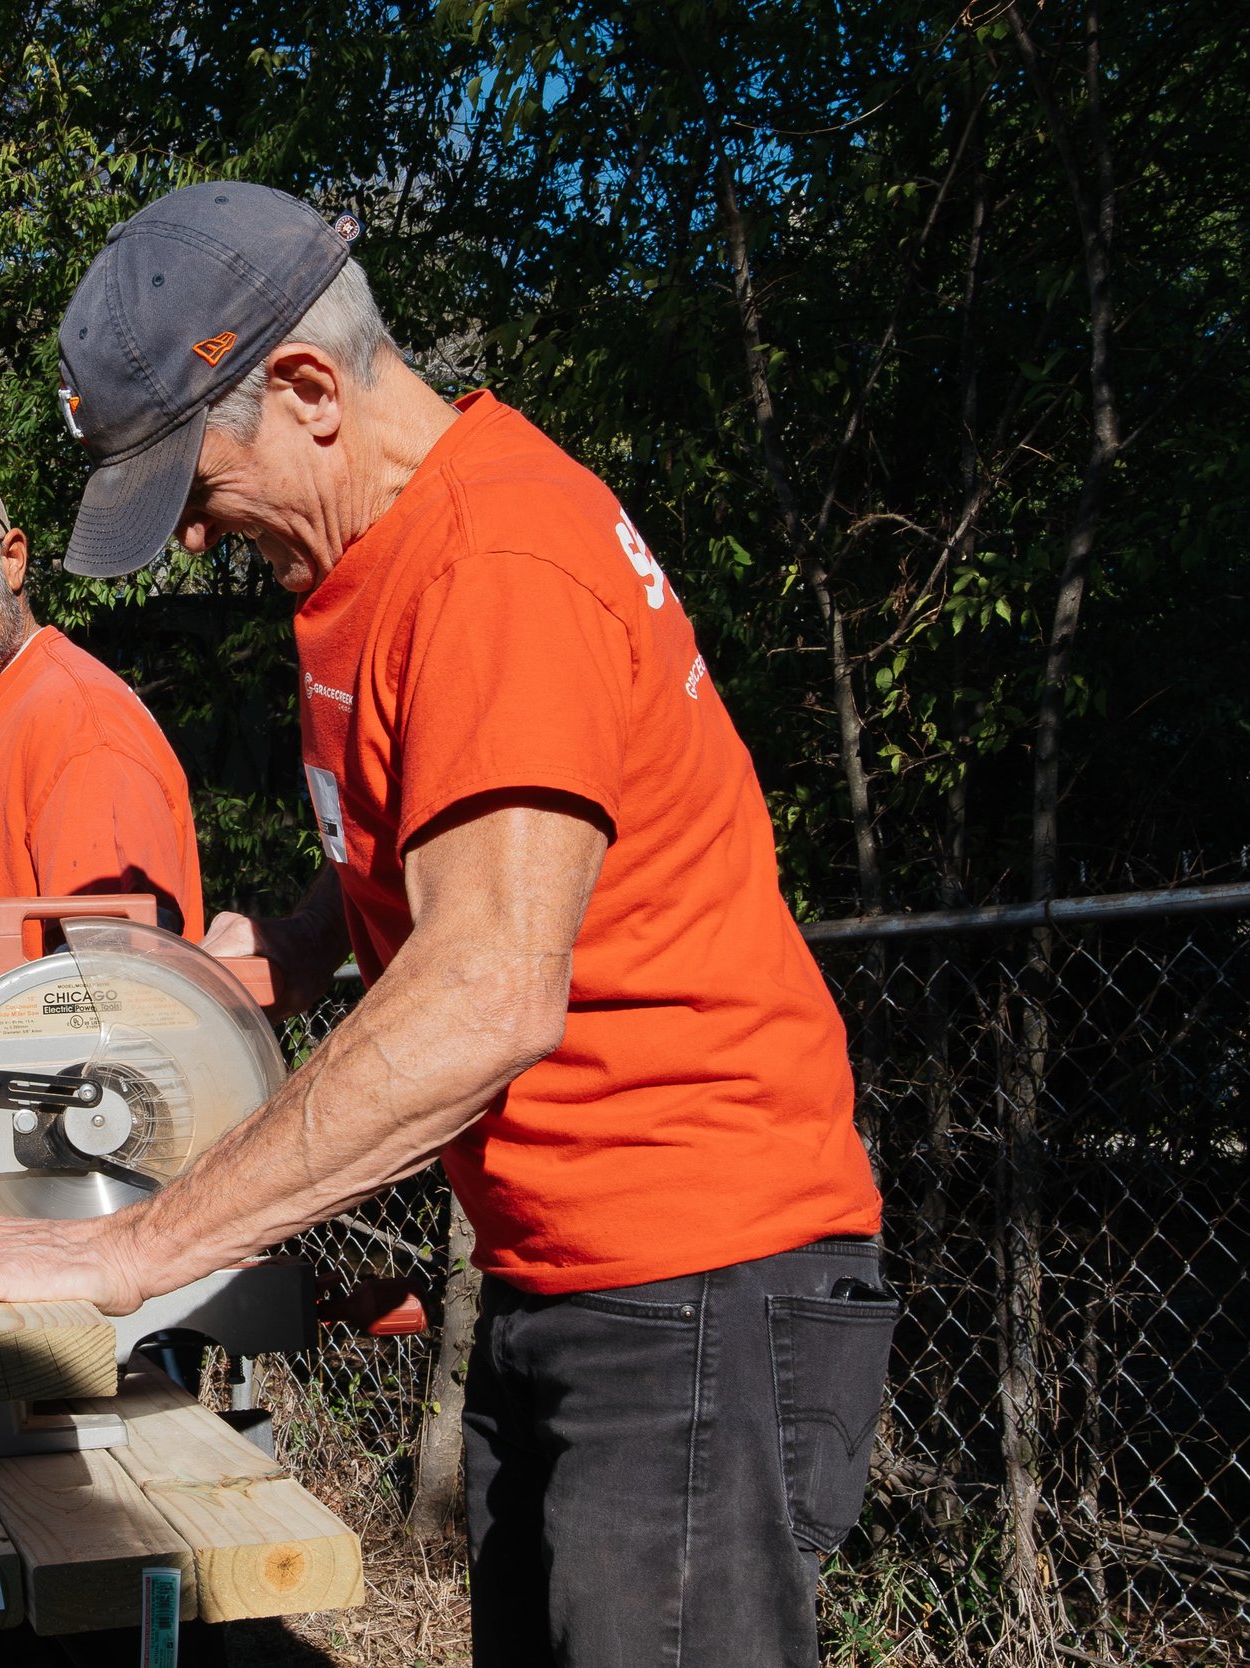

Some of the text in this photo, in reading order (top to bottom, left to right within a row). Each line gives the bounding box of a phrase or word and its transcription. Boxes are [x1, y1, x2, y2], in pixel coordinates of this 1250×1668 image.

[313, 682, 354, 705] GRACECREEK
[44, 990, 117, 1003] CHICAGO
[44, 1005, 73, 1014] Electric
[100, 1002, 120, 1012] Tools
